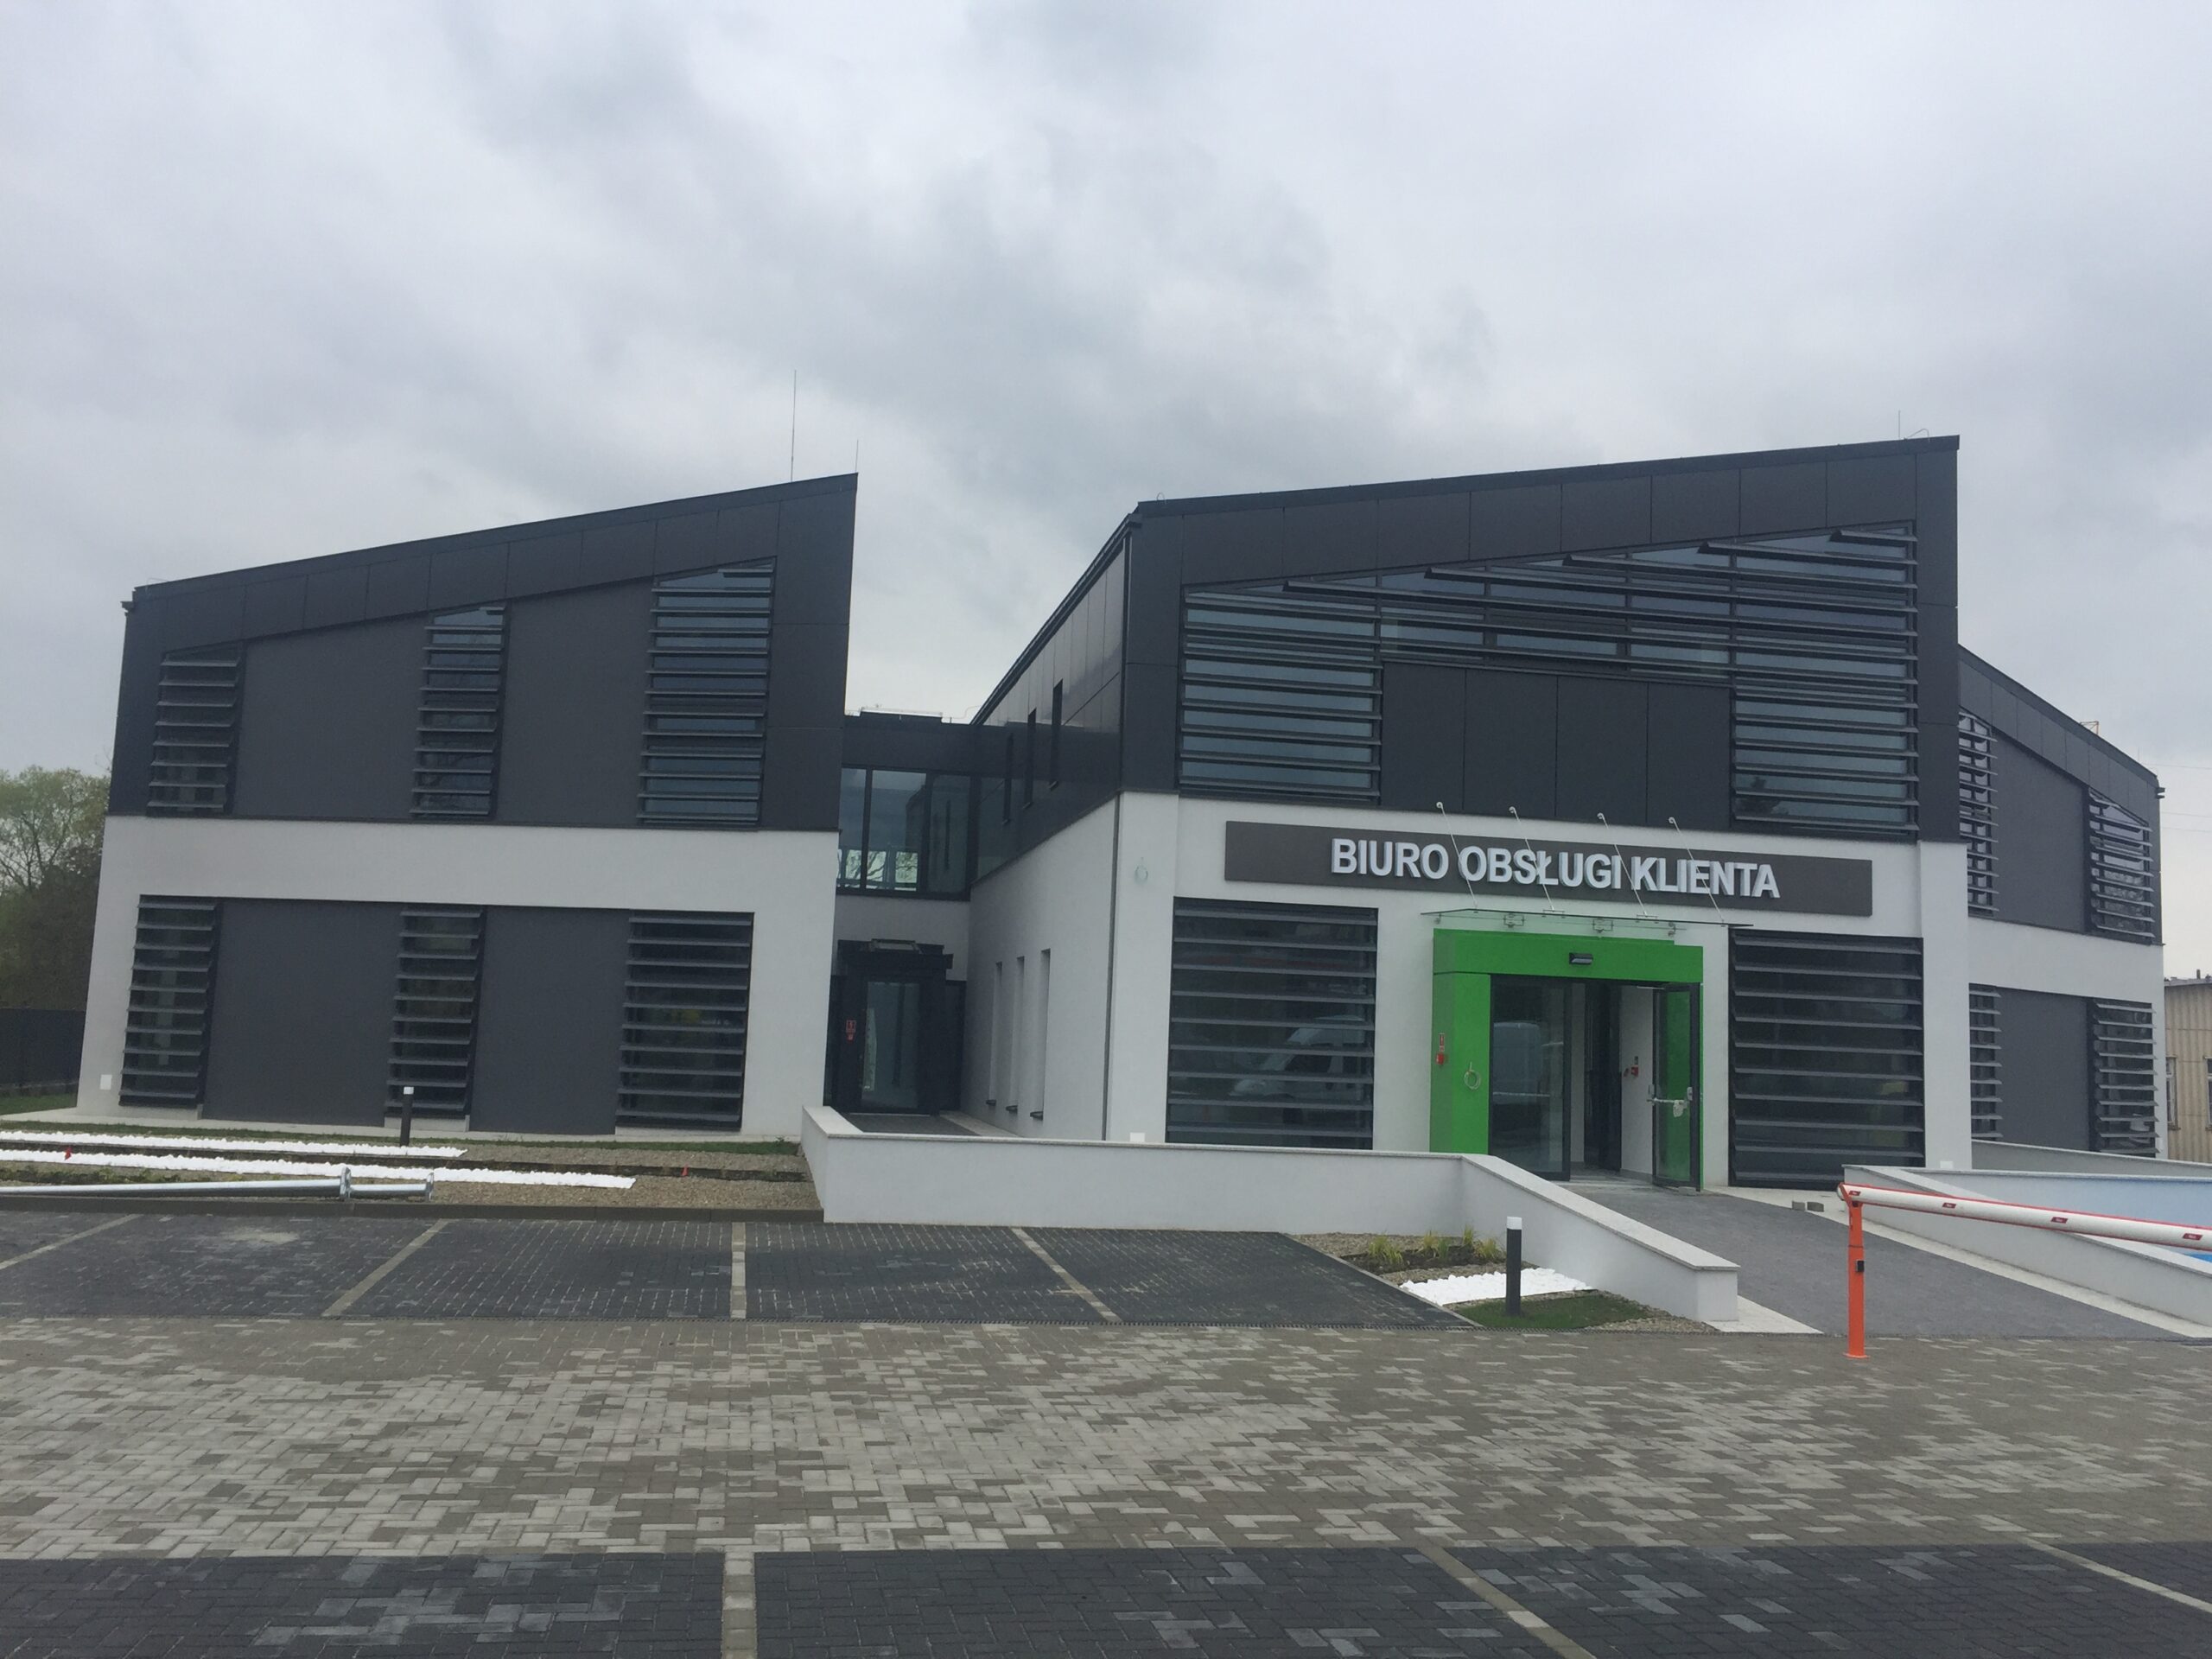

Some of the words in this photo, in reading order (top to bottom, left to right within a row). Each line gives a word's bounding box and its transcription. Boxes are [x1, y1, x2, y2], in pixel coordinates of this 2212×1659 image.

[1332, 838, 1449, 880] BIURO
[1459, 846, 1621, 889] OBSŁUGI
[1631, 856, 1781, 898] KLIENTA
